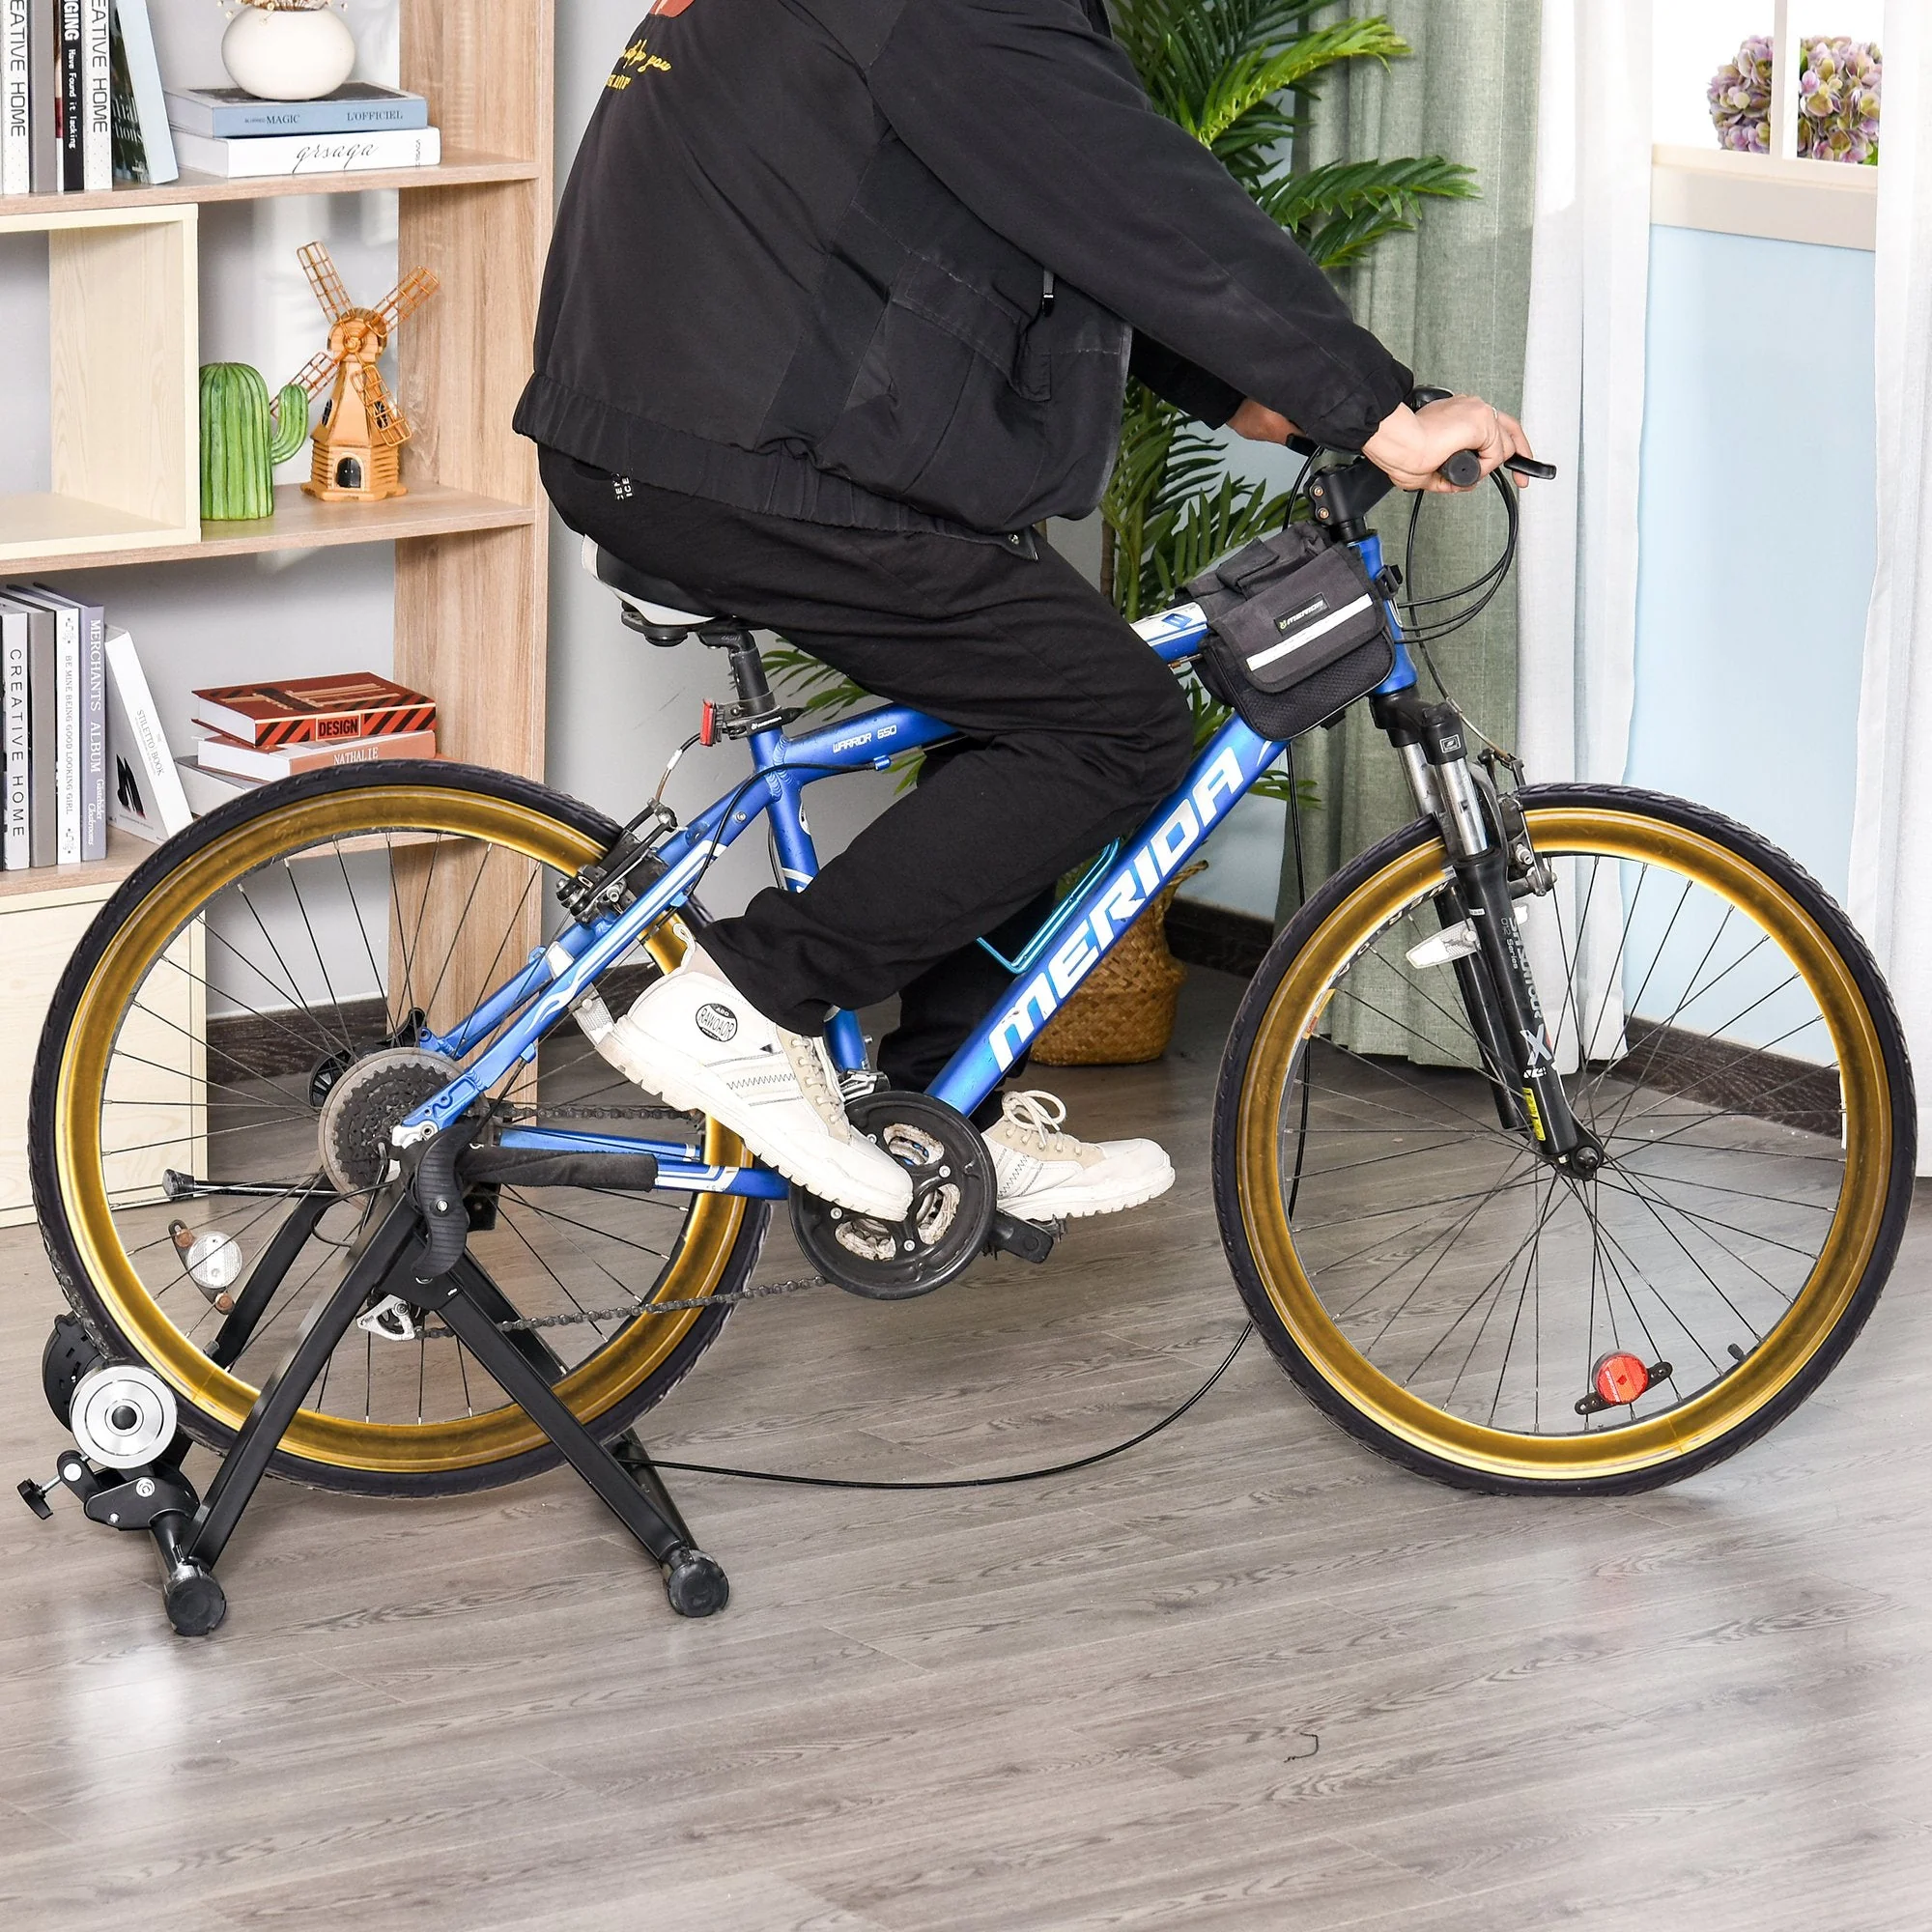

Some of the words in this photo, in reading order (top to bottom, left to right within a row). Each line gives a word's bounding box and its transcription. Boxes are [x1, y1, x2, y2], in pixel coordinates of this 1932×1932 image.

[64, 0, 79, 41] GING
[68, 49, 77, 69] Have
[68, 72, 77, 98] Found
[11, 82, 26, 136] HOME
[69, 101, 76, 111] it
[93, 77, 108, 132] HOME
[266, 114, 300, 125] MAGIC
[347, 110, 404, 122] L'OFFICIEL
[69, 116, 78, 150] lacking
[65, 655, 73, 668] BE
[90, 619, 101, 712] MERCHANTS
[65, 670, 73, 693] MINE
[10, 648, 24, 761] CREATIVE
[65, 694, 73, 723] BEING
[65, 724, 73, 750] GOOD
[136, 709, 156, 749] STILETTO
[151, 751, 165, 777] BOOK
[319, 720, 357, 736] DESIGN
[833, 732, 872, 753] WARRIOR
[877, 724, 897, 740] 650
[90, 722, 101, 773] ALBUM
[334, 747, 378, 764] NATHALIE
[65, 752, 73, 790] LOOKING
[12, 775, 25, 837] HOME
[65, 793, 73, 815] GIRL
[988, 747, 1244, 1072] MERIDA
[1506, 938, 1519, 969] Series
